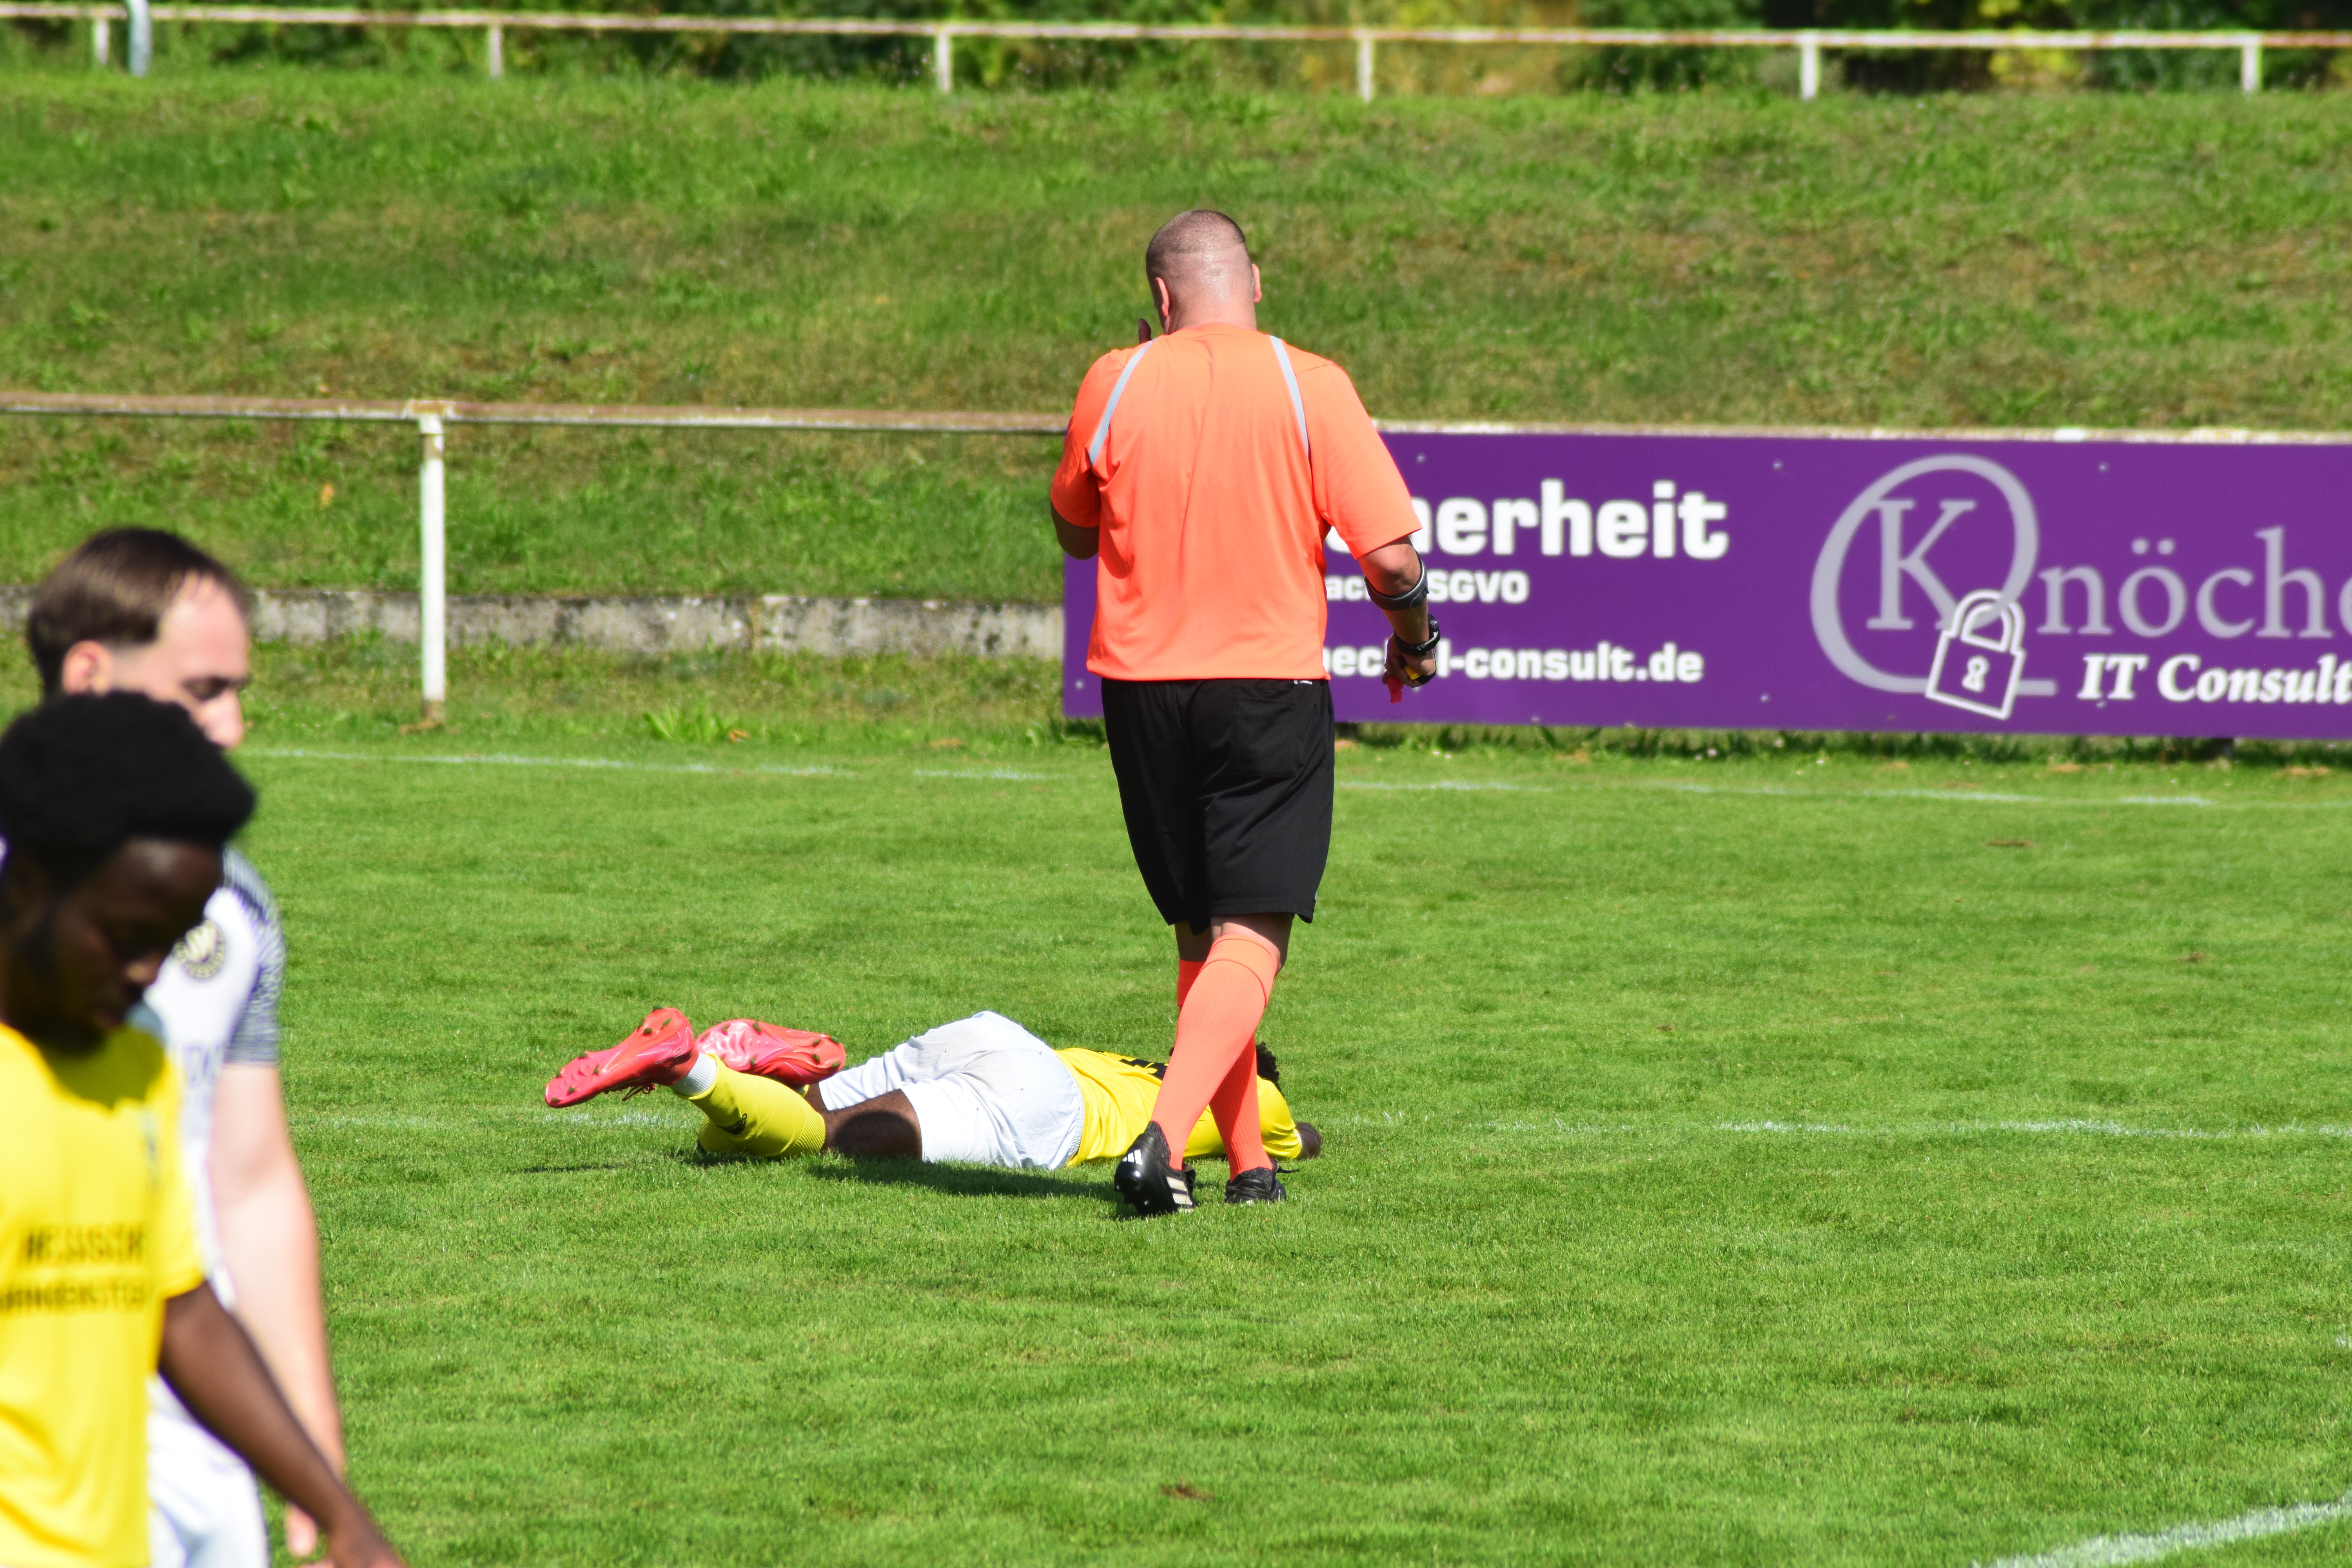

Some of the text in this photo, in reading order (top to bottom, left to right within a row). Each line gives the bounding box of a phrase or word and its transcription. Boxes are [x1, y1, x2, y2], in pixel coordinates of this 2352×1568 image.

[1327, 478, 1729, 560] erheit
[1865, 499, 2352, 639] Knöch
[2077, 653, 2149, 701] IT
